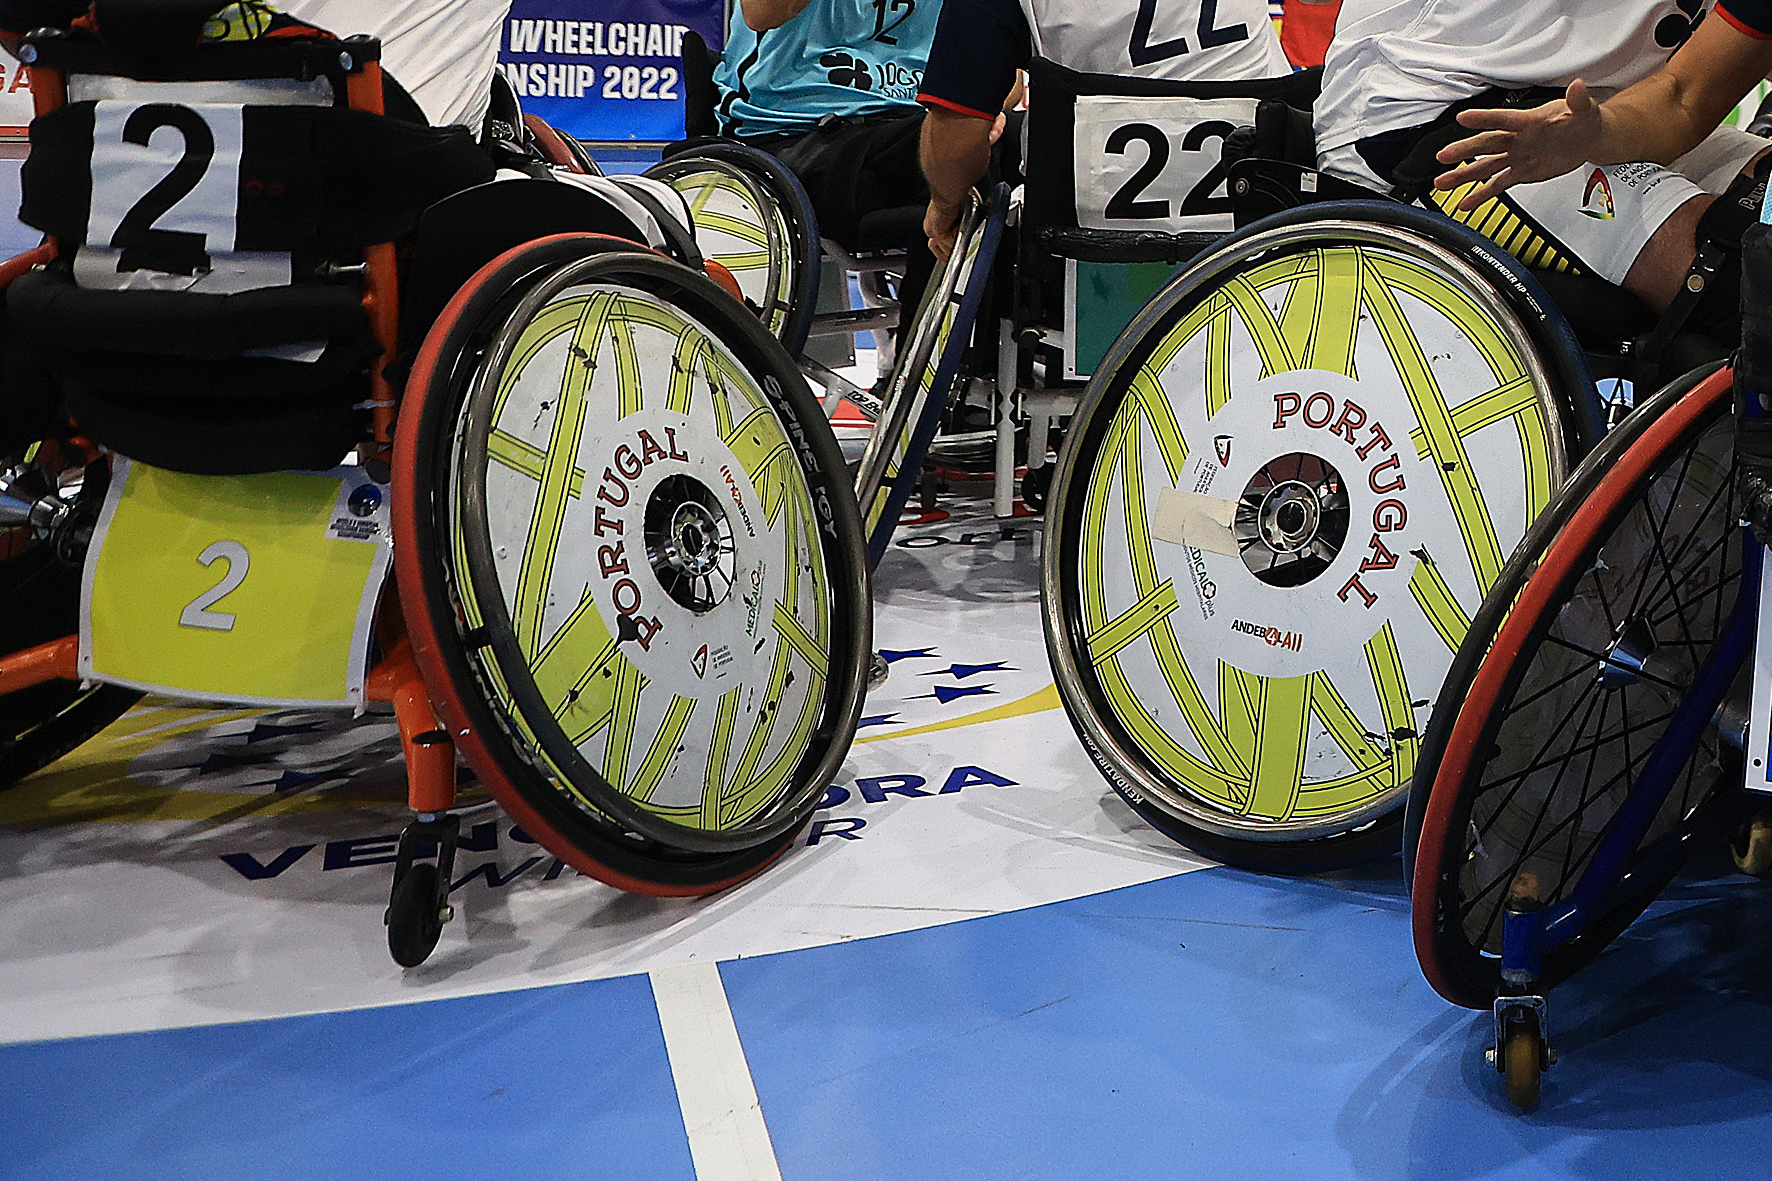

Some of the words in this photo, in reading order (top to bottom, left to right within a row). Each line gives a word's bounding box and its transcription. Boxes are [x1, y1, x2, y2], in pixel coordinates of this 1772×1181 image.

[602, 65, 679, 101] 2022
[112, 103, 215, 274] 2
[1103, 119, 1237, 220] 22
[593, 425, 689, 653] PORTUGAL
[1272, 391, 1408, 610] PORTUGAL
[178, 540, 251, 632] 2
